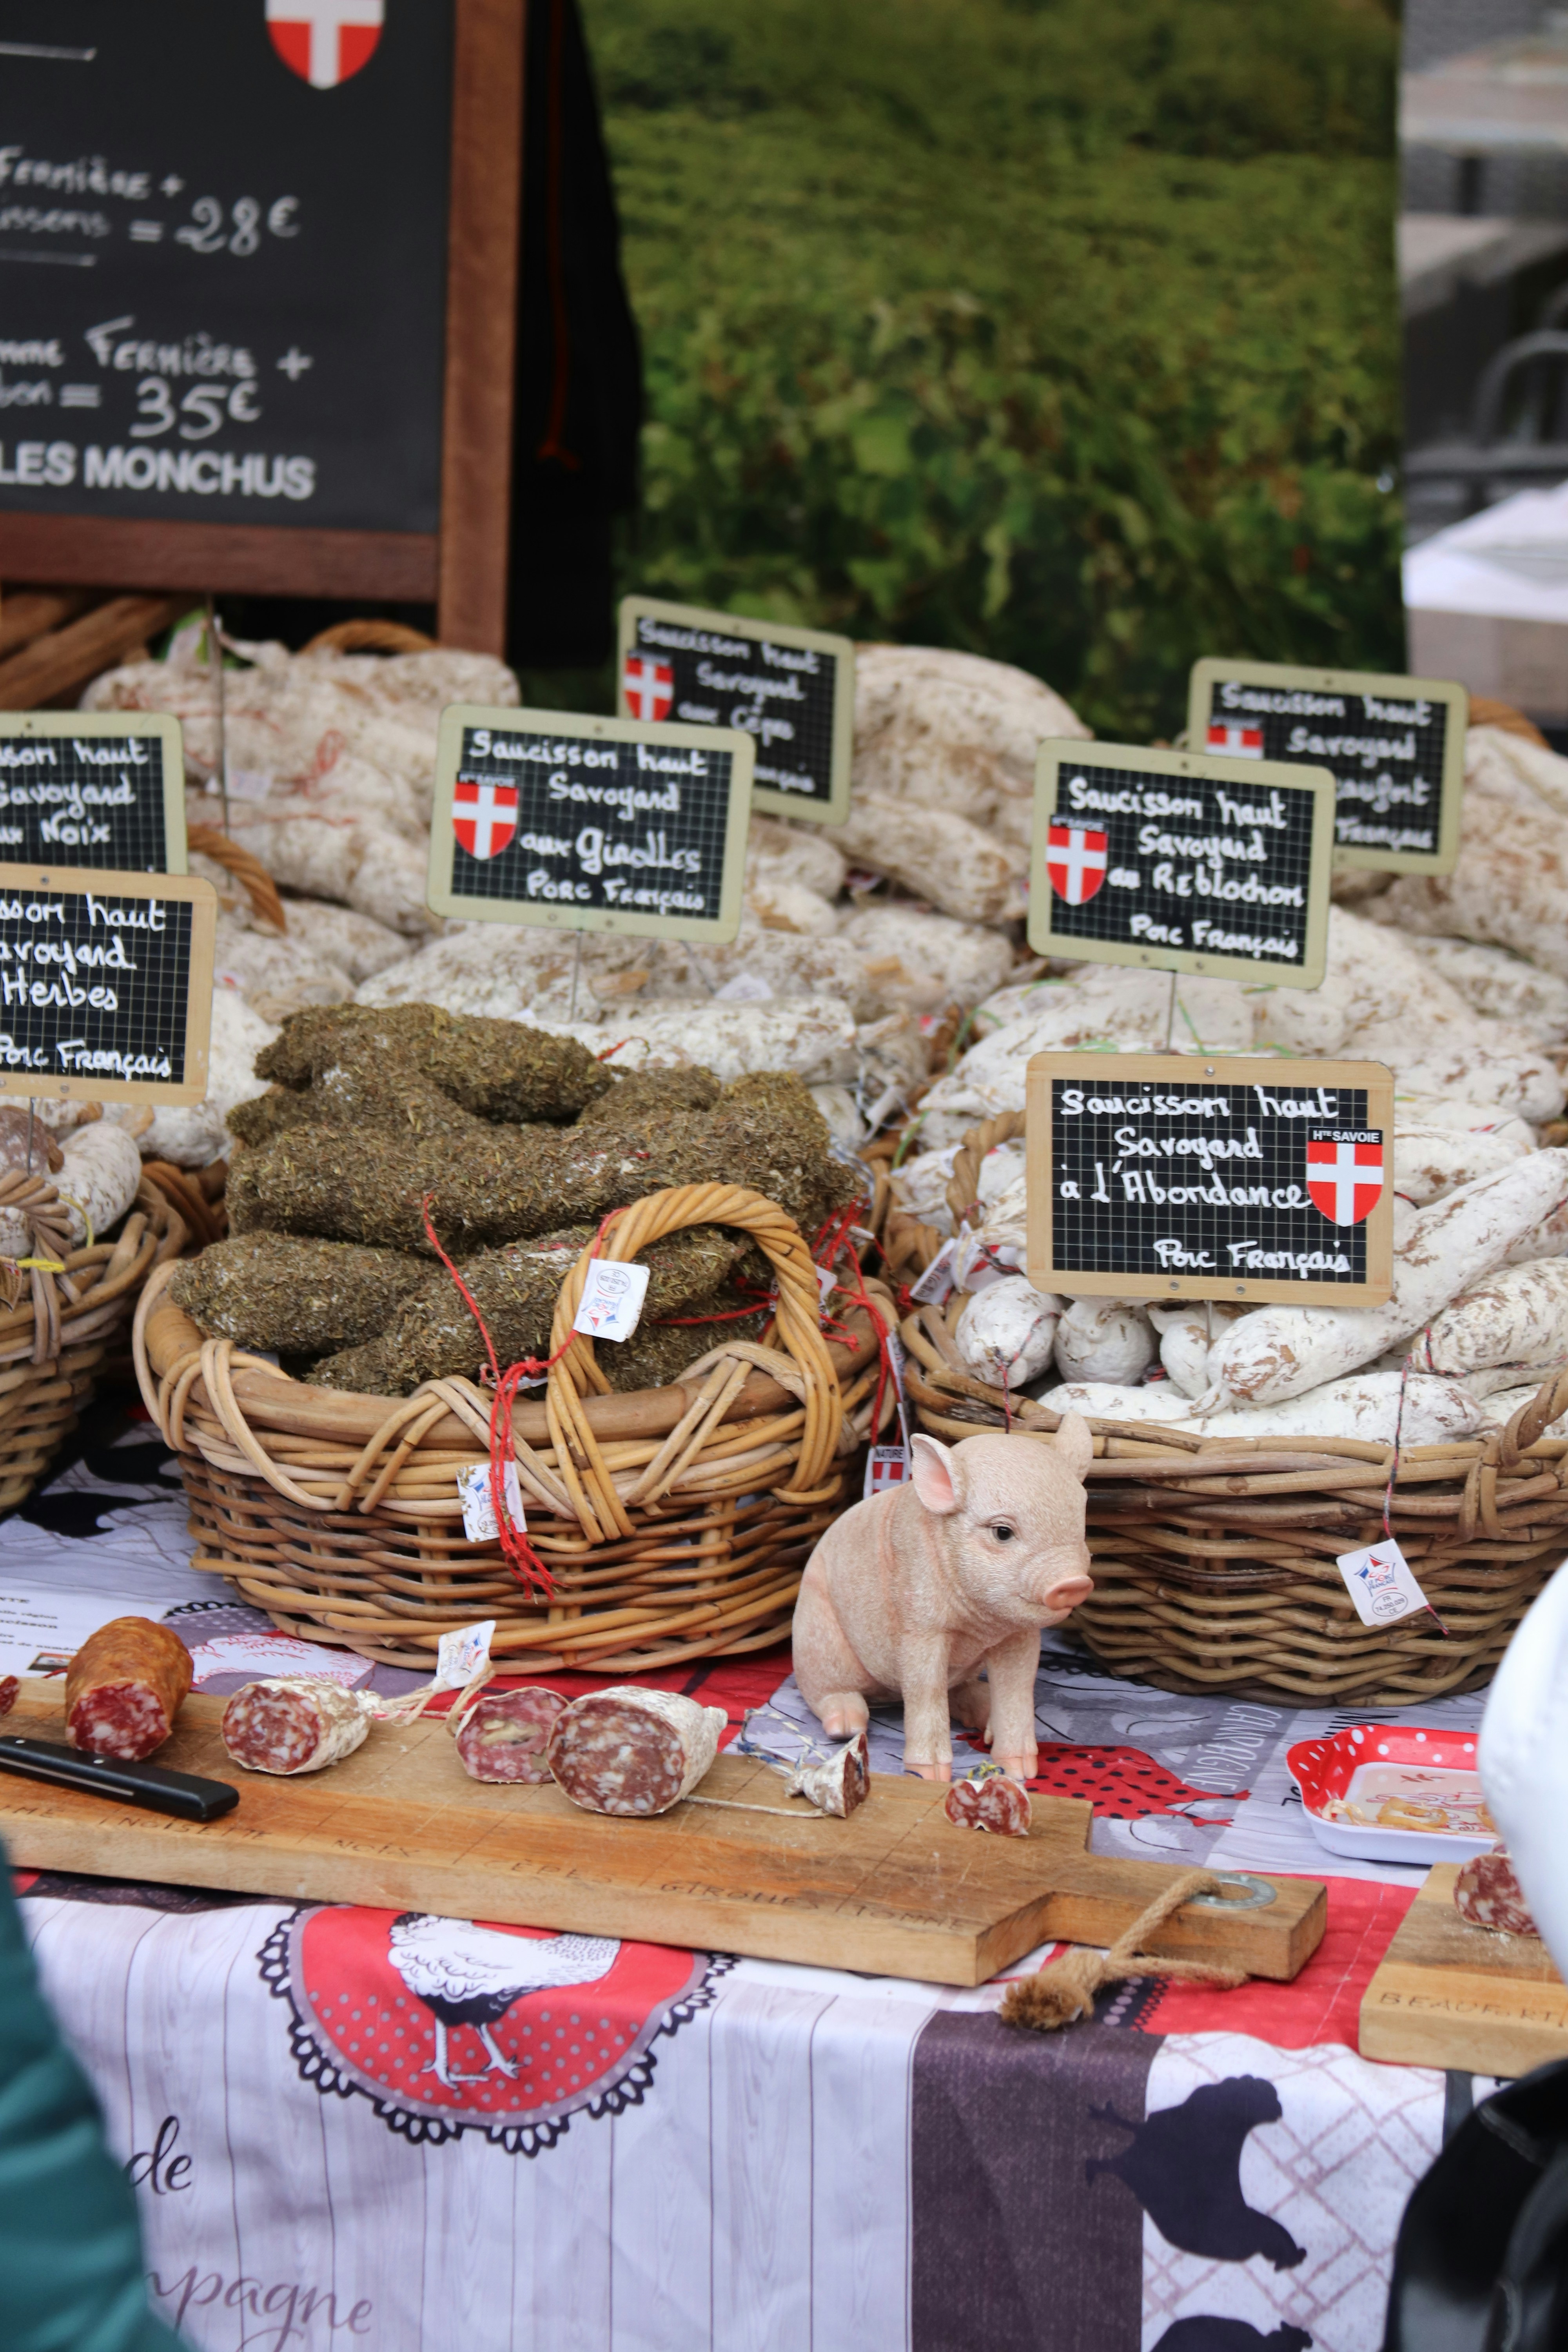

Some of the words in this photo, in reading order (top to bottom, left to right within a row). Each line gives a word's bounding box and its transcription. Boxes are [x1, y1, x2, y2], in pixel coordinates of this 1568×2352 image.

[175, 195, 300, 256] 28€
[276, 347, 312, 381] +
[60, 383, 101, 408] =
[129, 376, 261, 440] 35€
[84, 444, 316, 500] MONCHUS
[638, 616, 750, 659] Saucisson
[696, 660, 807, 705] Savoyard
[1220, 681, 1345, 717] Saucisson
[1363, 693, 1432, 727] haut
[73, 736, 148, 765] haut
[470, 730, 618, 770] Saucisson
[637, 744, 708, 776] haut
[1286, 726, 1416, 768] Savoyard
[550, 771, 681, 821] Savoyard
[1069, 775, 1202, 819] Saucisson
[1216, 789, 1287, 829] haut
[40, 808, 110, 846] Noix
[520, 832, 571, 858] aux
[1138, 824, 1267, 870] Savoyard
[526, 869, 592, 902] Porc
[603, 877, 704, 915] Français
[1107, 866, 1141, 889] au
[1152, 862, 1305, 907] Reblochon
[86, 892, 166, 932] haut
[1129, 913, 1183, 945] Porc
[1192, 920, 1298, 960] Français
[2, 966, 118, 1011] Herbes
[56, 1039, 172, 1082] Français
[1060, 1086, 1231, 1118] Saucisson
[1254, 1084, 1339, 1119] haut
[1114, 1127, 1264, 1171] Savoyard
[1332, 1131, 1380, 1144] SAVOIE
[1060, 1164, 1081, 1200] à
[1153, 1238, 1216, 1270] Porc
[1225, 1240, 1351, 1279] Français
[876, 1449, 903, 1459] NATURE
[1181, 1704, 1283, 1791] CAMPAGNE
[1379, 1991, 1559, 2023] BEAUFORT
[124, 2115, 193, 2195] de
